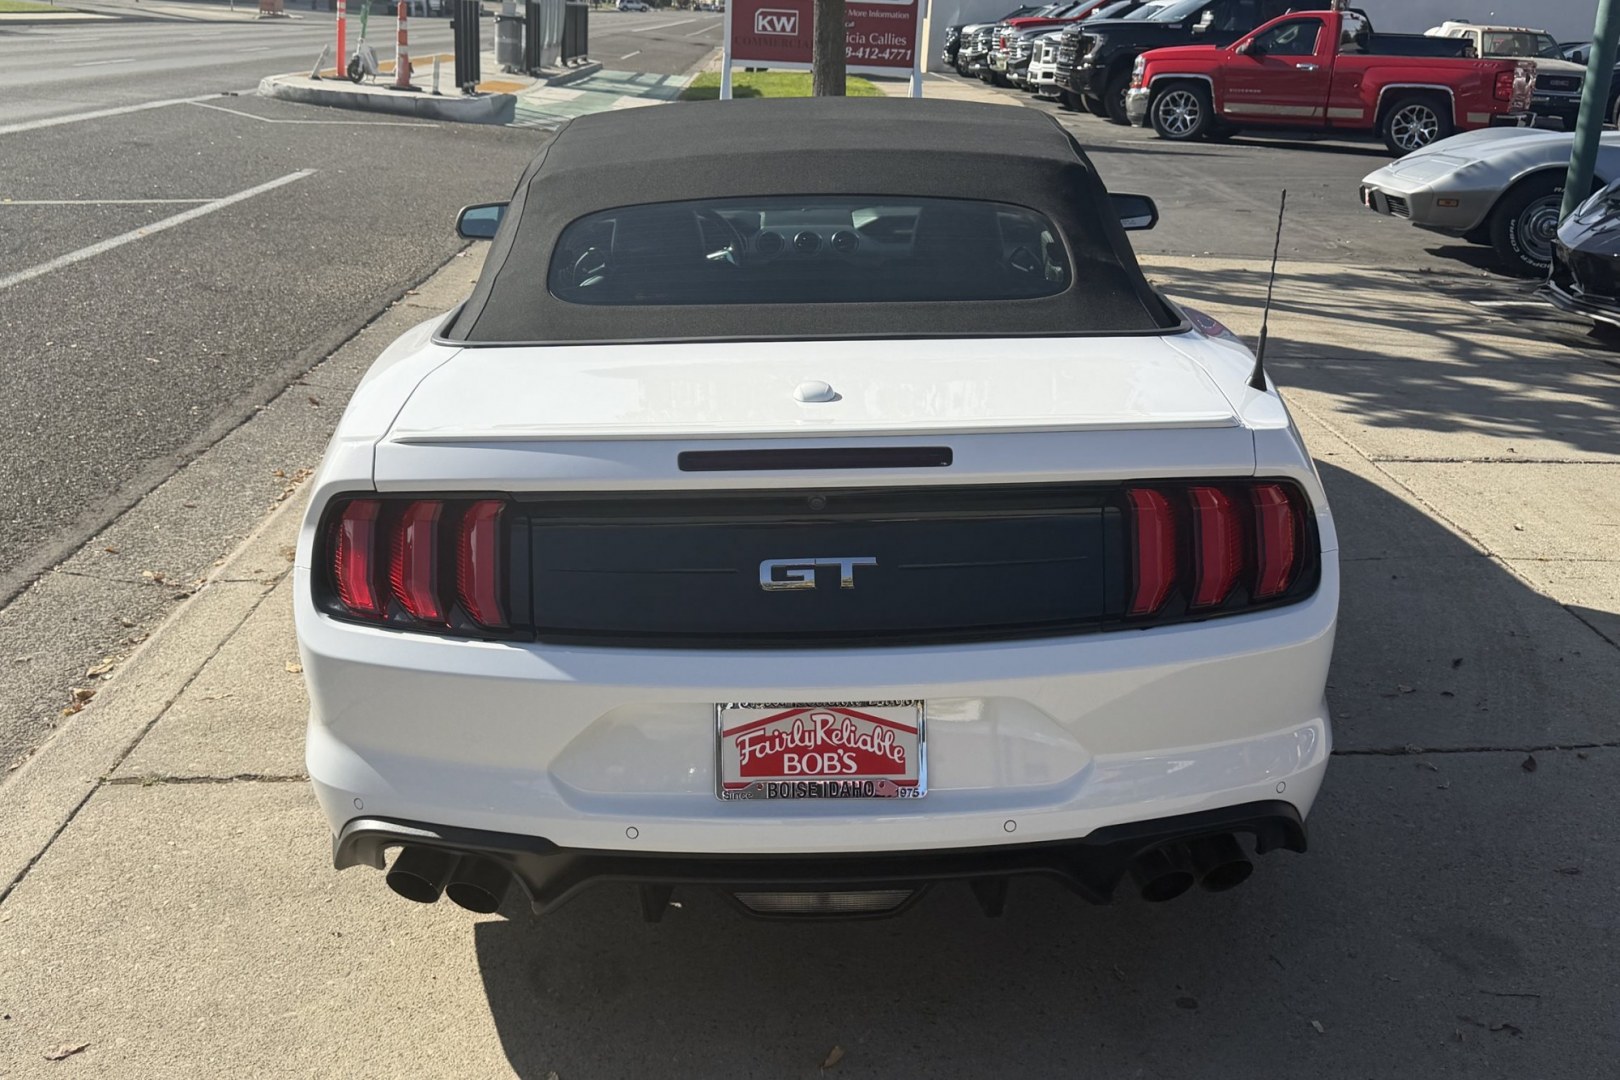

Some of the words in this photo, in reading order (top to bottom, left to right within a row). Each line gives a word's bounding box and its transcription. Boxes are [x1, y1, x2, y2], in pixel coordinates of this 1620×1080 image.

[848, 9, 867, 17] More
[869, 10, 910, 19] Information
[758, 15, 796, 32] KW
[734, 36, 810, 48] COMMERCIA
[845, 32, 866, 44] icia
[869, 33, 907, 46] Callies
[845, 46, 912, 60] 8-412-4771
[759, 557, 878, 591] GT
[736, 719, 815, 766] Fairly
[811, 713, 905, 764] Reliable
[783, 749, 858, 774] BOB'S
[723, 791, 753, 800] Since
[767, 781, 817, 799] BOISE
[824, 781, 876, 798] IDAHO
[895, 788, 920, 798] 1975
